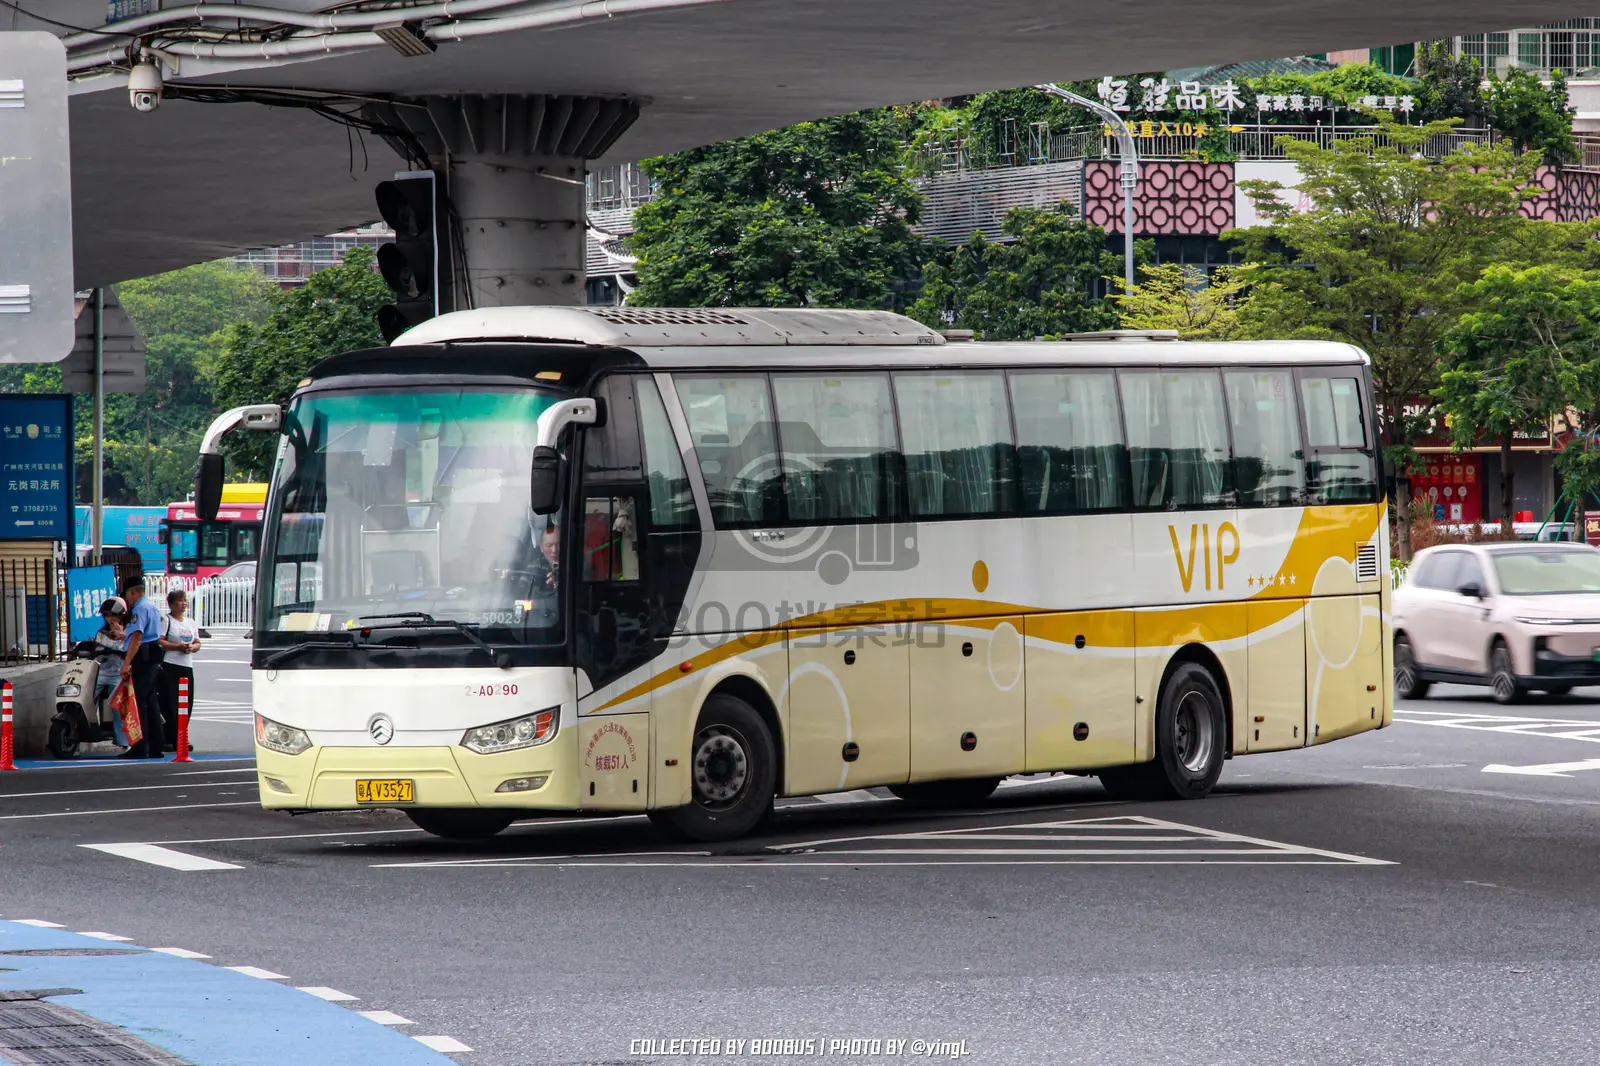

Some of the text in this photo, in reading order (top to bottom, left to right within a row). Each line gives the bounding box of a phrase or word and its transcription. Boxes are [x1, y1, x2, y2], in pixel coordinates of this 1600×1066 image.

[8, 479, 60, 491] 元岗司法所
[1168, 521, 1240, 593] VIP
[595, 754, 630, 771] 核载51人
